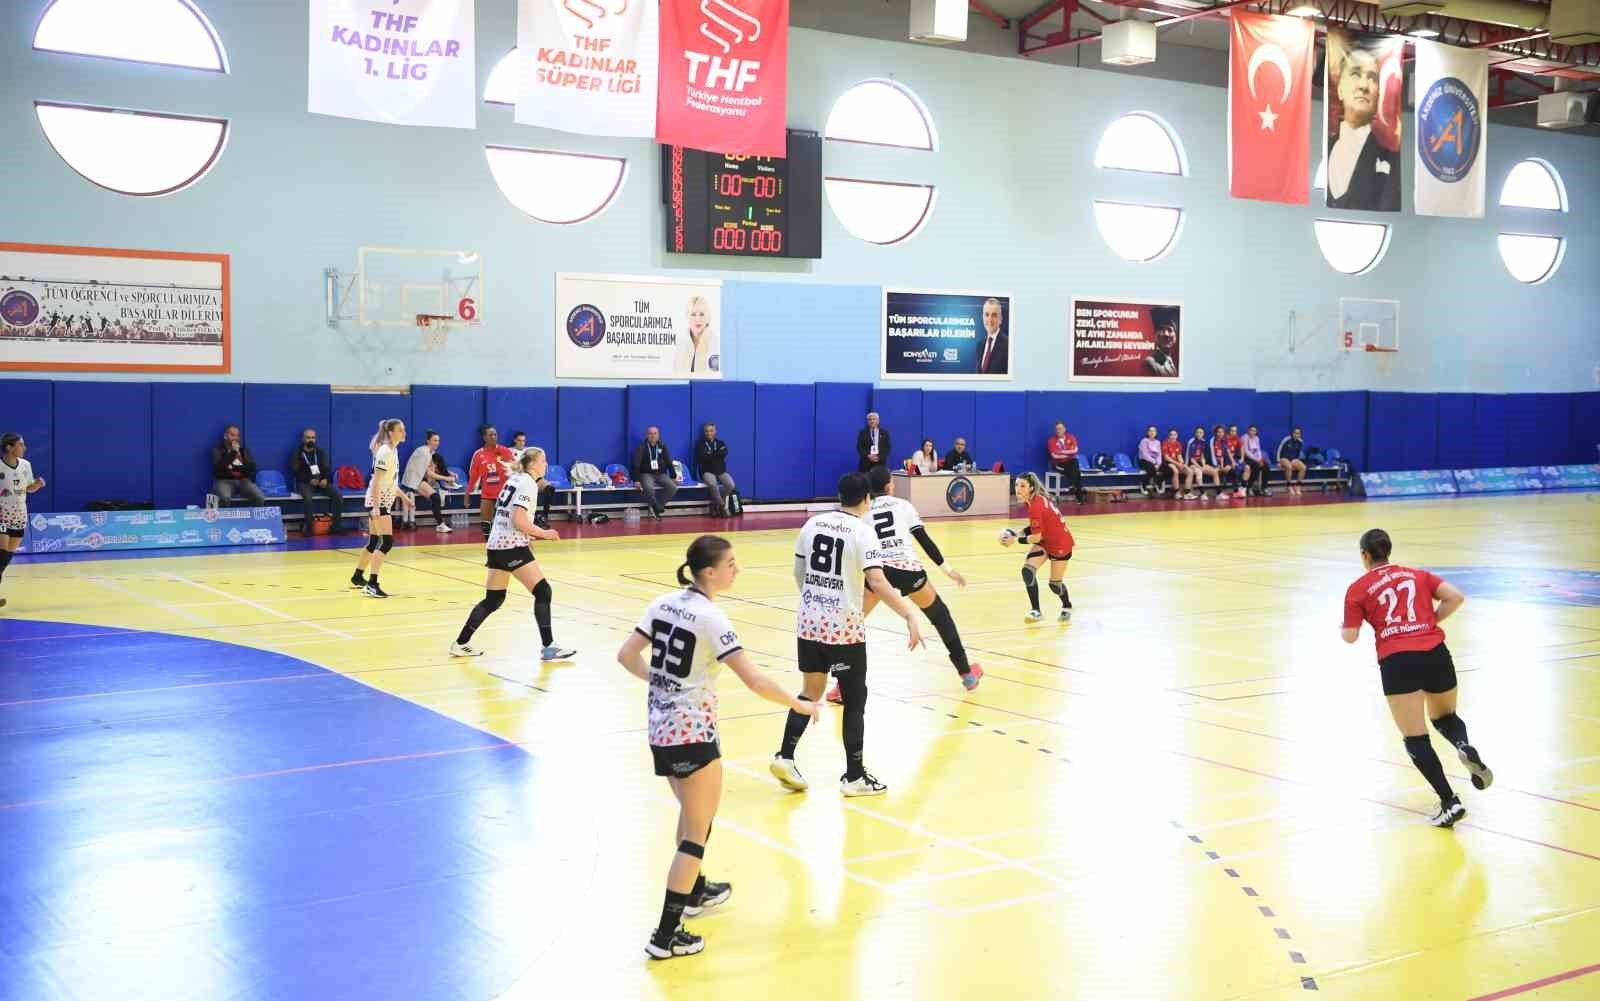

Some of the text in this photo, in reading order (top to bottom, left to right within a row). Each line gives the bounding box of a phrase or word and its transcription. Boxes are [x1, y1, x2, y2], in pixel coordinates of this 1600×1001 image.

[371, 10, 419, 33] THF
[331, 24, 460, 58] KADINLAR
[573, 34, 610, 53] THF
[364, 57, 428, 81] 1. LİG
[537, 47, 637, 74] KADINLAR
[684, 50, 761, 92] THF
[536, 66, 642, 95] SÜPER LİGİ
[685, 99, 747, 118] Federasyonu
[686, 86, 762, 107] Türkiye Hentbol
[720, 174, 742, 197] 00
[754, 176, 776, 198] 00
[458, 297, 476, 321] 6
[634, 300, 650, 313] TÜM
[609, 314, 673, 330] SPORCULARIMIZA
[606, 330, 676, 347] BAŞARILAR DİLERİM
[1344, 331, 1353, 348] 5
[487, 463, 498, 473] 59
[873, 511, 896, 540] 2
[810, 533, 845, 576] 81
[1377, 579, 1417, 622] 27
